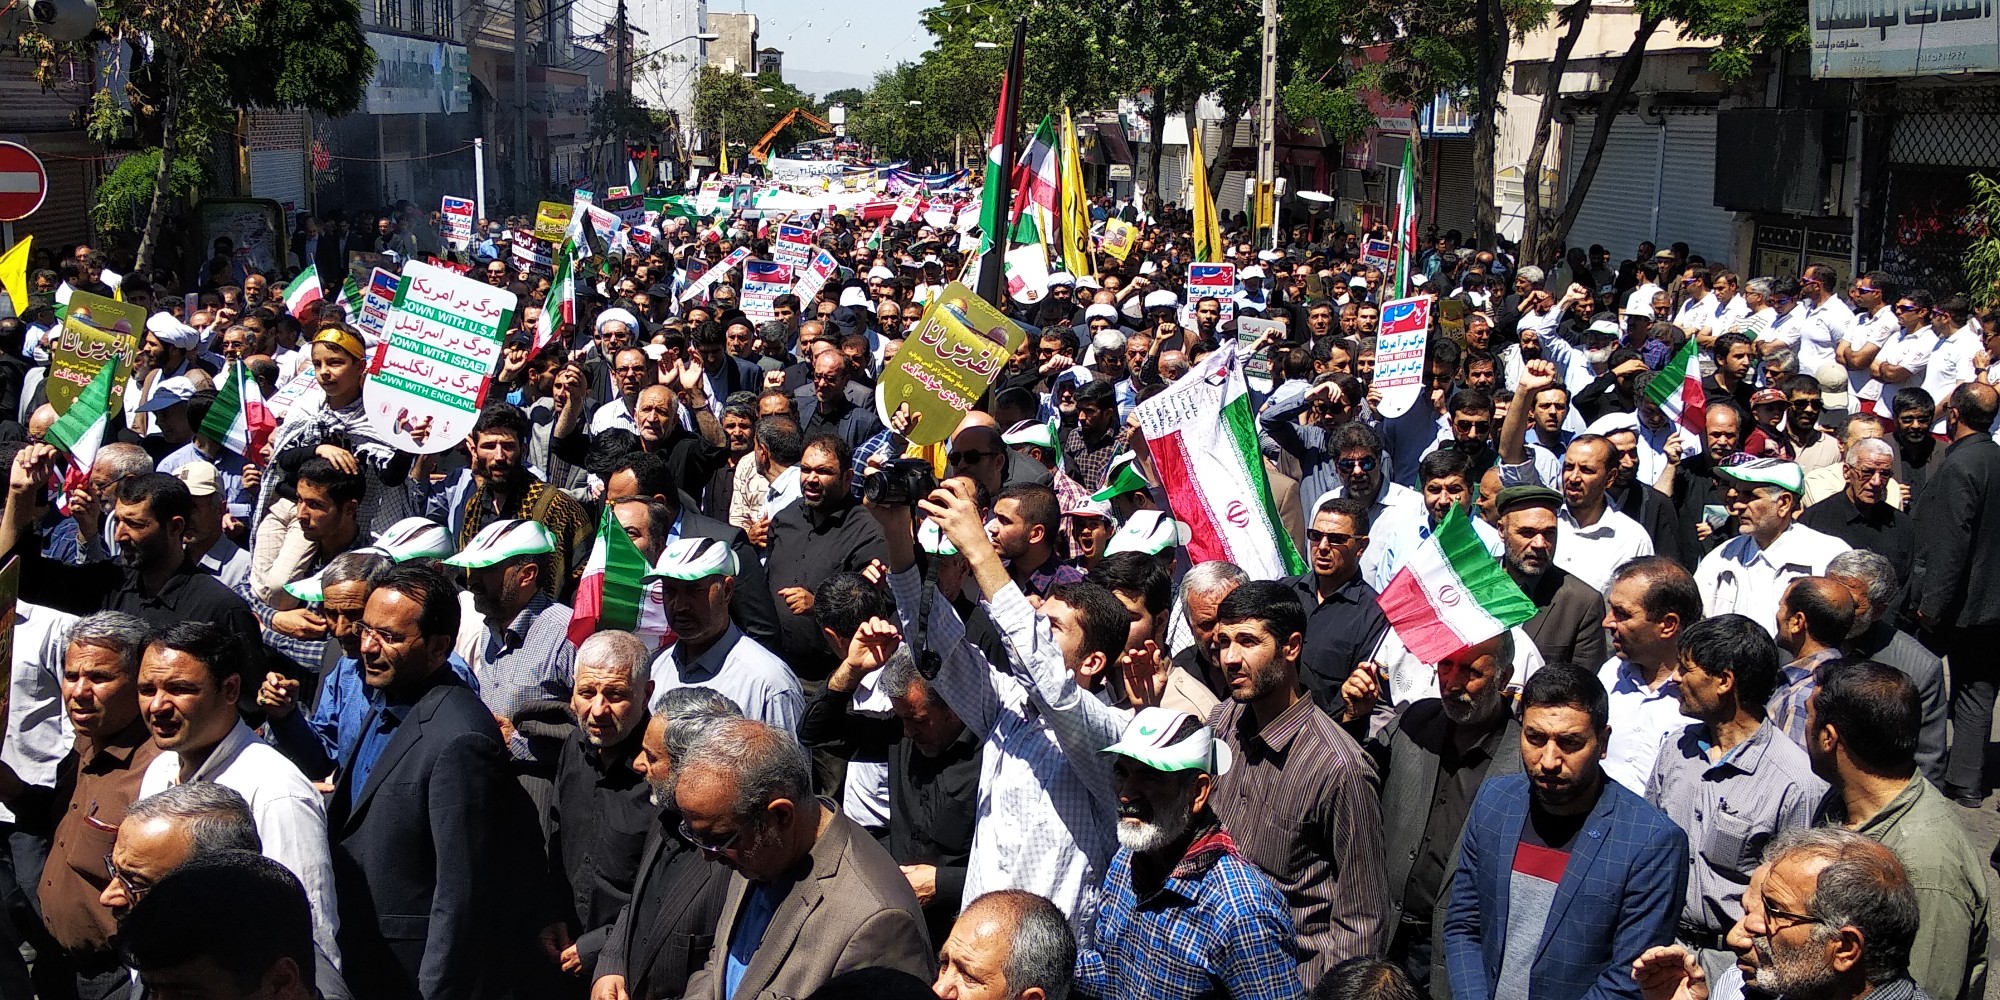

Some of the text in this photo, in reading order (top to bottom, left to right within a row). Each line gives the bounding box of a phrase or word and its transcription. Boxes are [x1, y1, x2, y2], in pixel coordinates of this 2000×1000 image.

[412, 277, 500, 317] مرگ بر امریکا
[745, 283, 767, 293] آمریکا
[1190, 287, 1211, 296] آمریکا
[1219, 288, 1232, 297] مرگ
[394, 315, 445, 340] اسرائیل
[438, 311, 466, 328] WITH
[61, 328, 80, 350] لنا
[444, 338, 459, 350] بر
[463, 337, 491, 356] مرگ
[1379, 334, 1424, 352] مرگ بر آمریکا
[422, 345, 449, 361] WITH
[451, 353, 487, 373] ISRAEL
[918, 317, 1001, 385] القدس لنا
[54, 368, 70, 379] آمد
[381, 359, 478, 394] مرگ بر انگلیس
[901, 362, 923, 376] آمد
[1376, 360, 1421, 378] مرگ بر اسرائیل
[68, 372, 92, 386] خواهد
[405, 381, 429, 395] WITH
[916, 371, 942, 391] خواهد
[938, 390, 966, 411] زودی
